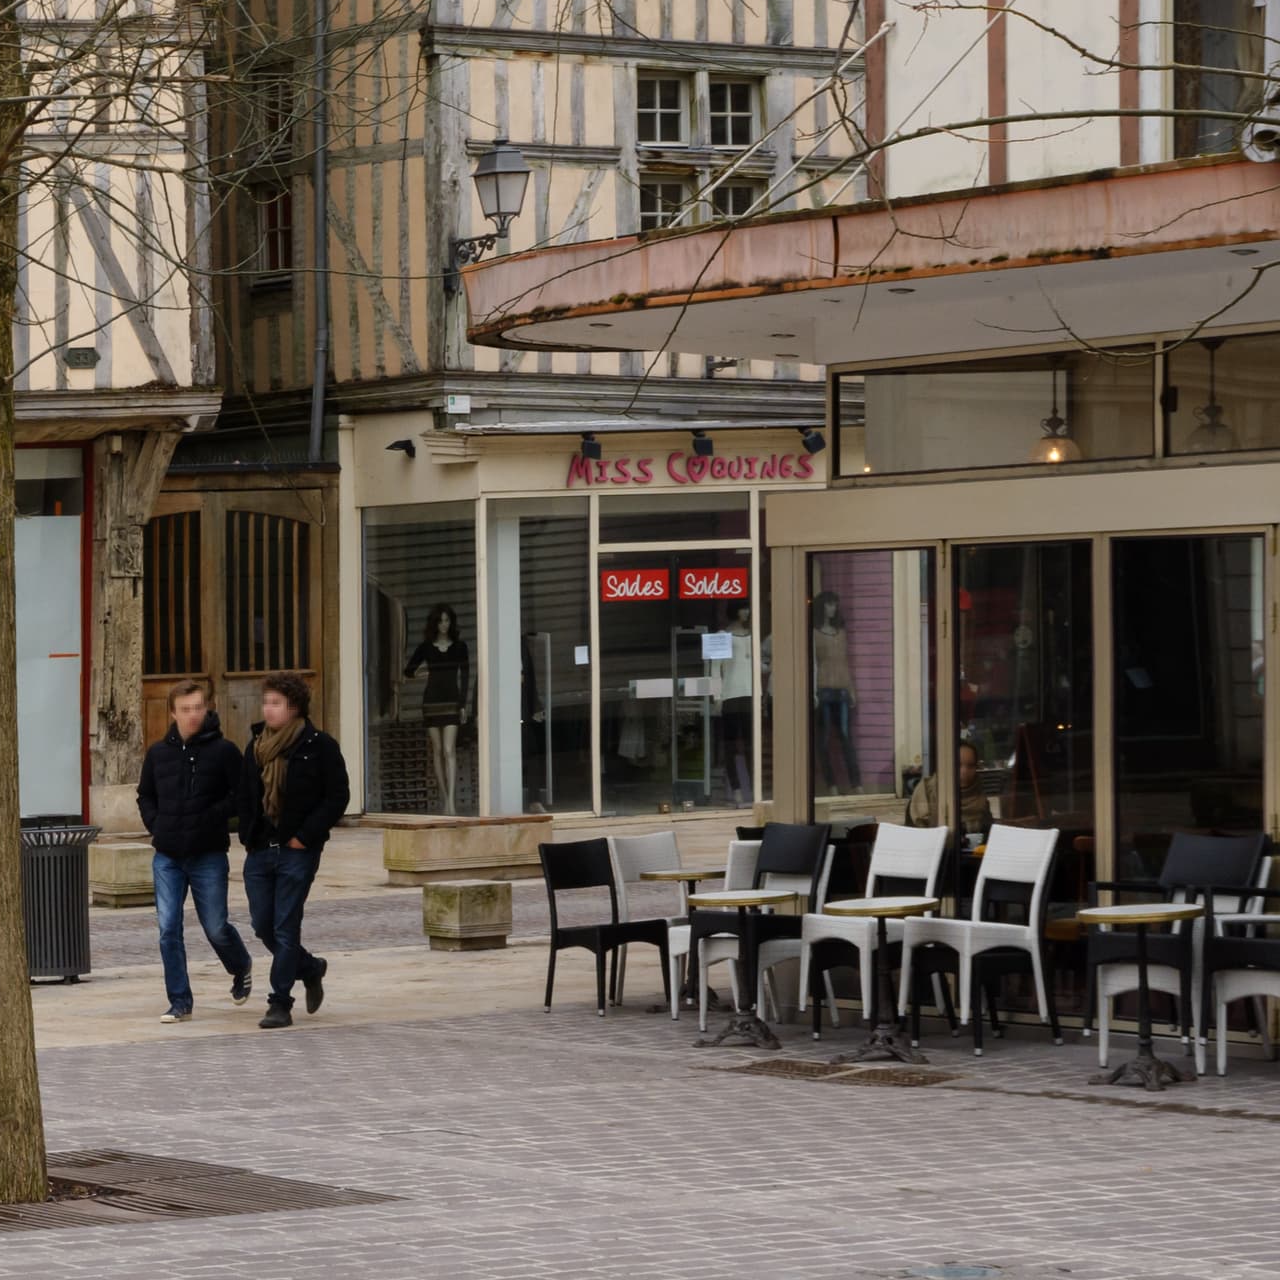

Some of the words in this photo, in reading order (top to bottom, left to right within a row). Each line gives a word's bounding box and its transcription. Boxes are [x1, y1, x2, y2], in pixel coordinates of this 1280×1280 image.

[566, 453, 654, 488] MISS
[666, 451, 816, 484] COQUINES
[604, 573, 665, 598] Soldes
[682, 572, 743, 597] Soldes
